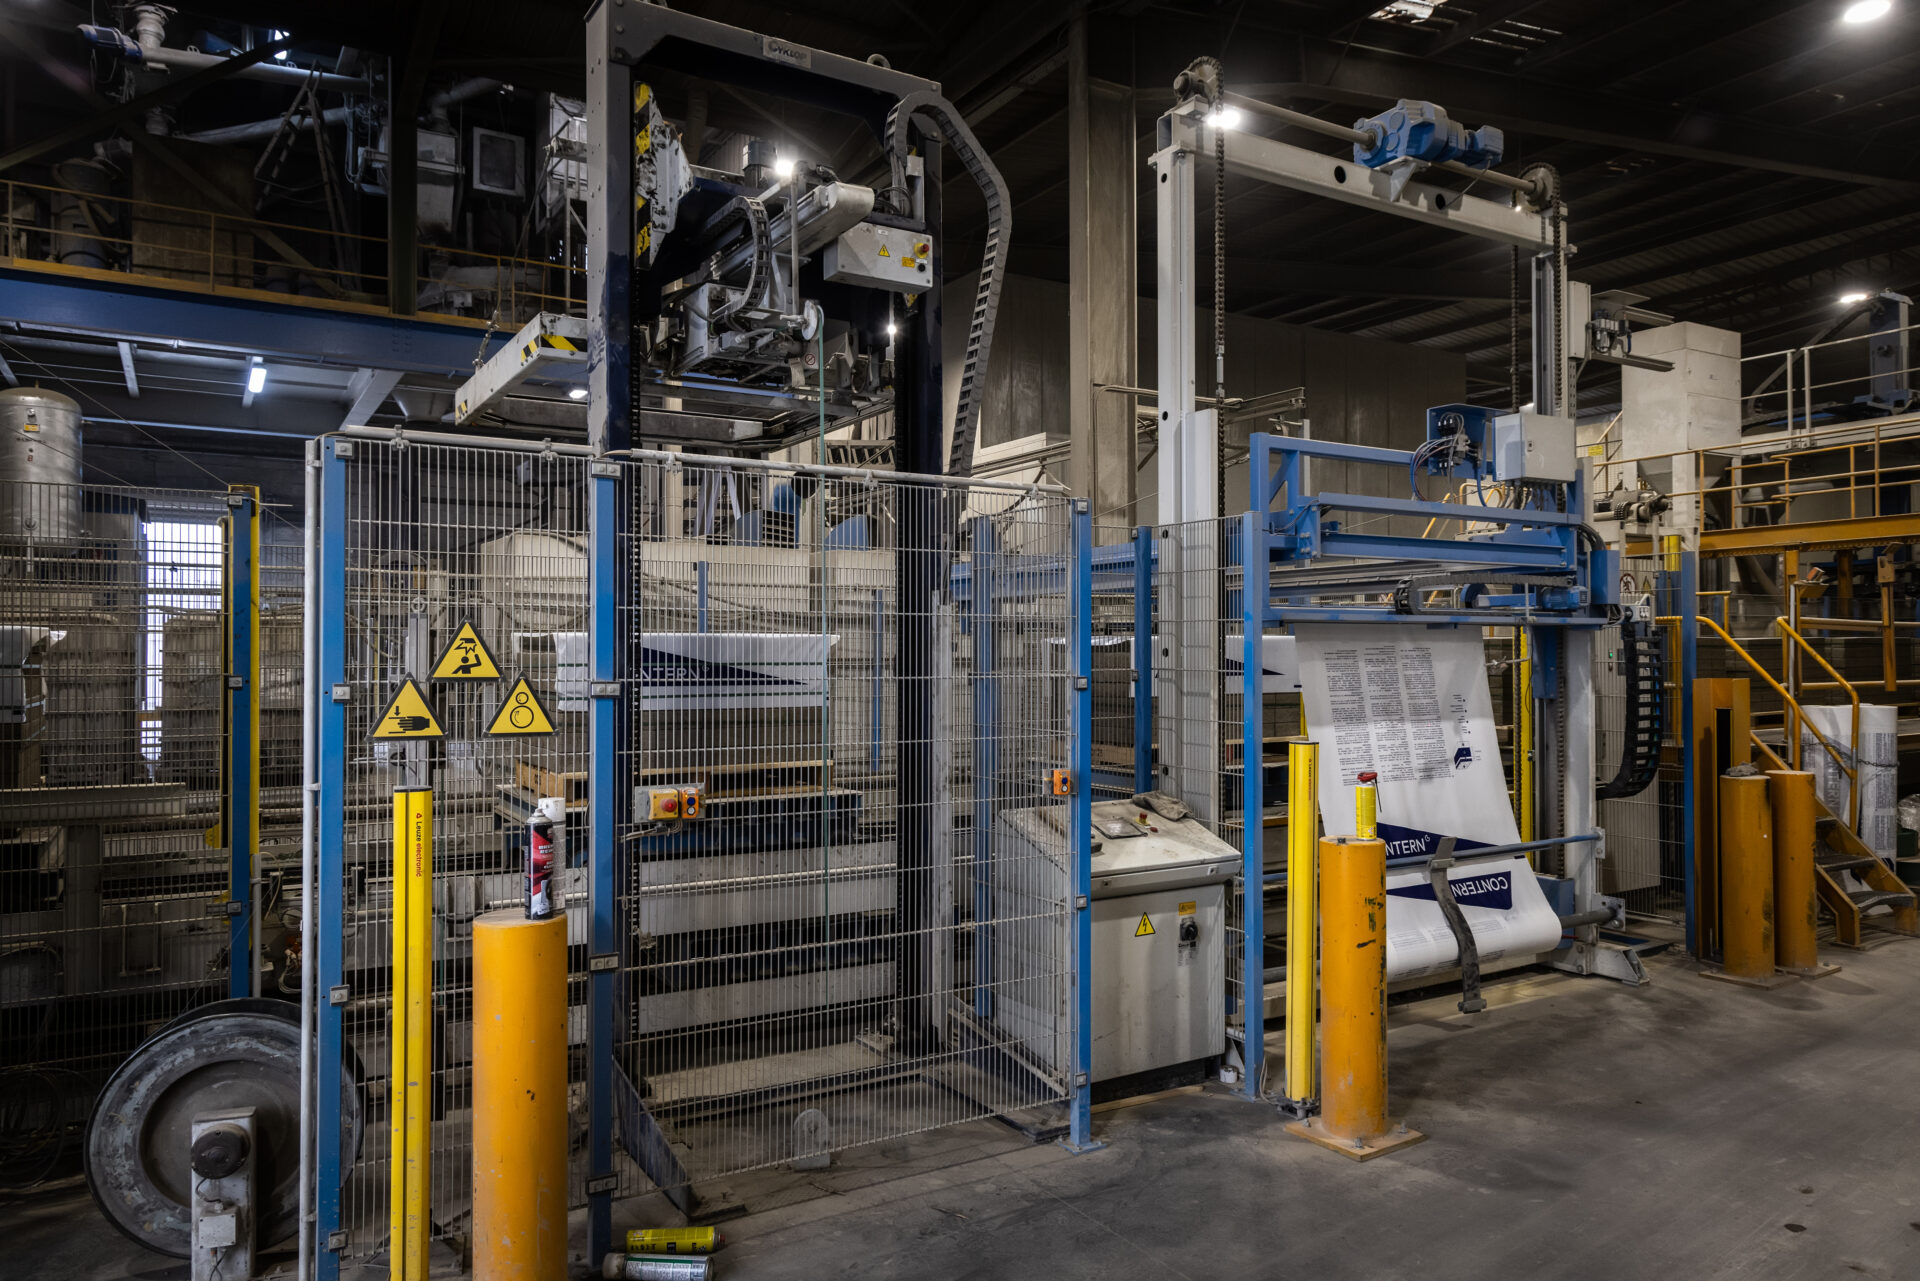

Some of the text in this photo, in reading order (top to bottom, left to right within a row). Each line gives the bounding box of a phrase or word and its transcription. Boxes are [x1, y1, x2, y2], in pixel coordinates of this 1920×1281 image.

[640, 667, 699, 681] NTERN
[1385, 838, 1426, 856] NTERN
[1451, 877, 1508, 897] CONTERN
